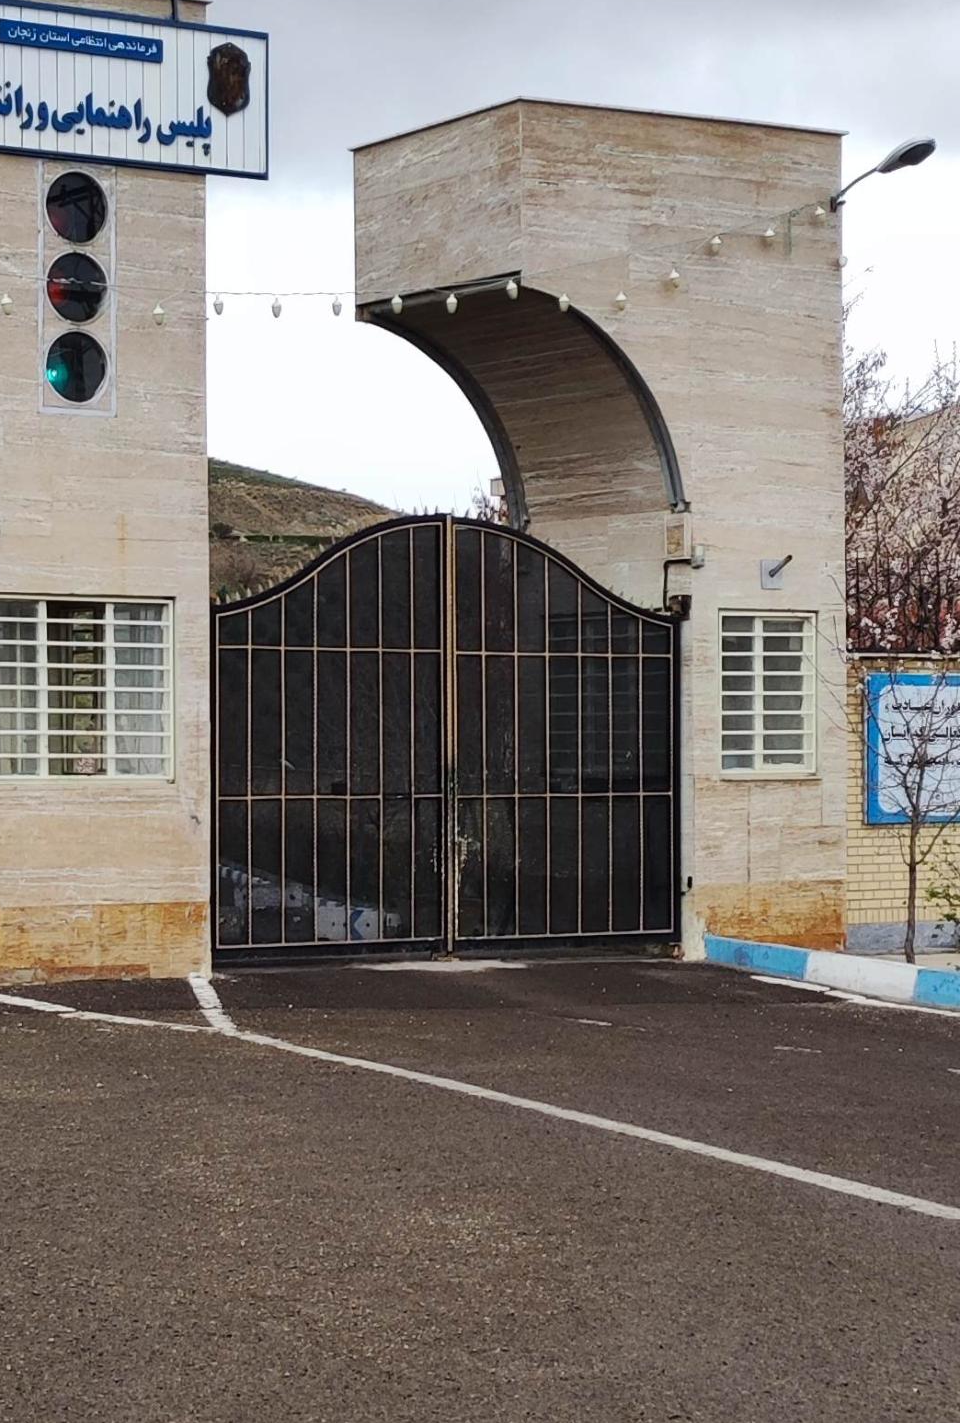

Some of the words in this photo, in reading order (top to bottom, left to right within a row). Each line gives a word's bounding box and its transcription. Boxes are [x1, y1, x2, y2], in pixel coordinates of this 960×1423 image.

[7, 25, 37, 41] زنجان
[39, 29, 71, 43] استان
[71, 35, 108, 49] انتظامی
[108, 39, 158, 56] فرماندهی
[34, 100, 49, 131] و
[50, 91, 152, 143] راهنمایی
[156, 105, 213, 156] پلیس
